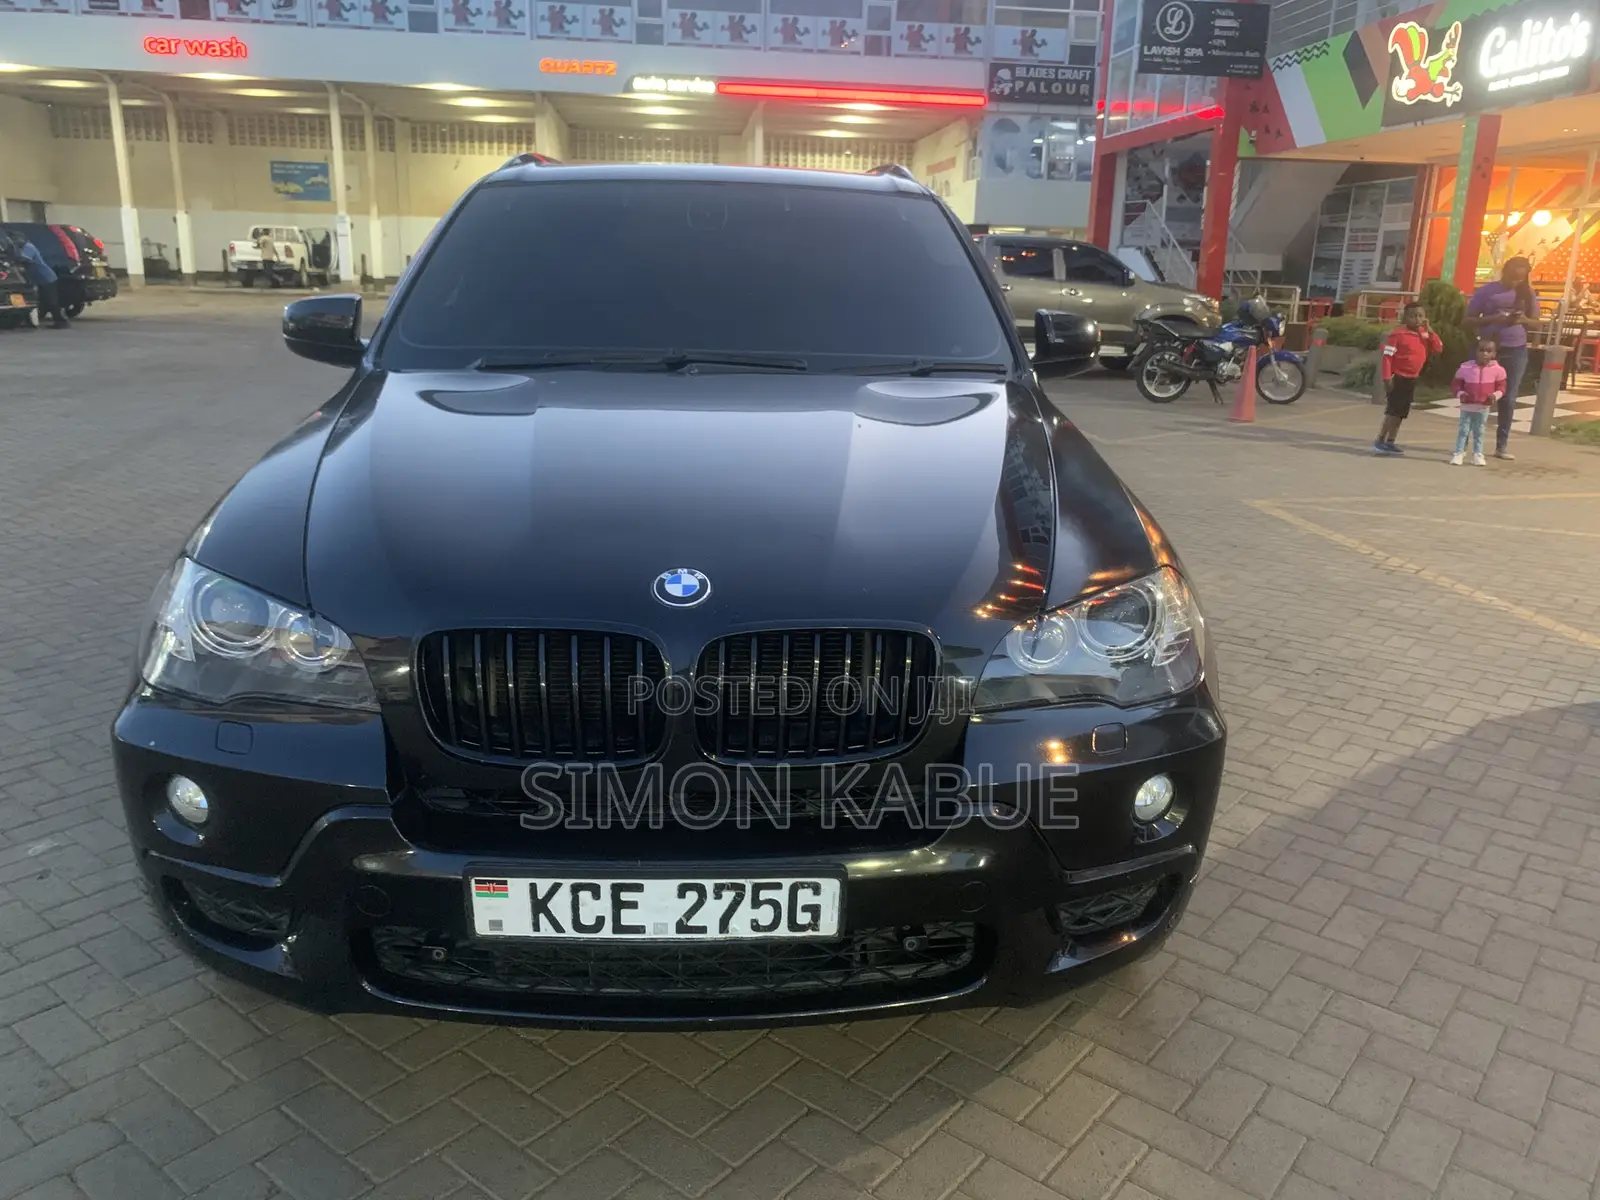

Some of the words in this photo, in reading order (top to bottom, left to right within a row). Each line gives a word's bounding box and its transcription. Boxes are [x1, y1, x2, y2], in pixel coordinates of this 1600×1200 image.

[143, 36, 180, 55] car
[184, 36, 247, 58] wash
[1143, 45, 1180, 56] LAVISH
[1183, 47, 1204, 57] SPA
[539, 57, 617, 76] QUARTZ
[1015, 66, 1056, 79] BLADES
[1057, 68, 1092, 81] CRAFT
[1014, 80, 1090, 96] PALOUR
[528, 881, 647, 935] KCE
[674, 881, 823, 935] 275G
